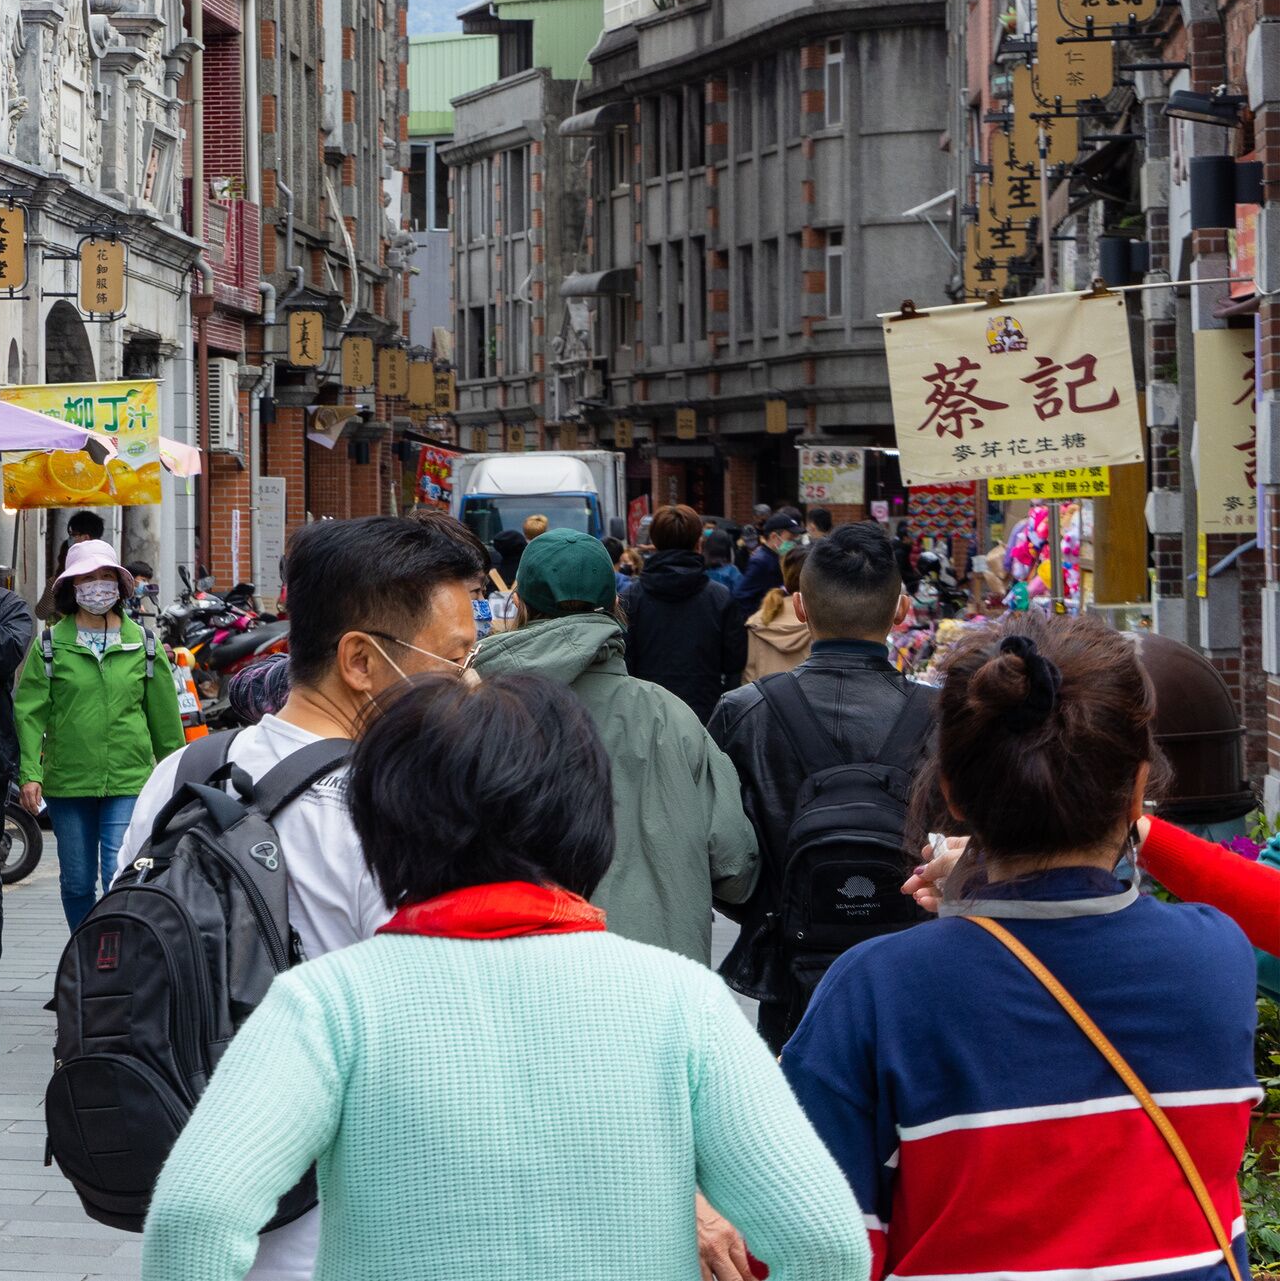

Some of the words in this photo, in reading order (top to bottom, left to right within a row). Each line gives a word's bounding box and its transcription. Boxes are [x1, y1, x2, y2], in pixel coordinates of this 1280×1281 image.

[917, 353, 1121, 440] 蔡記
[951, 431, 1088, 463] 麥芽花生糖
